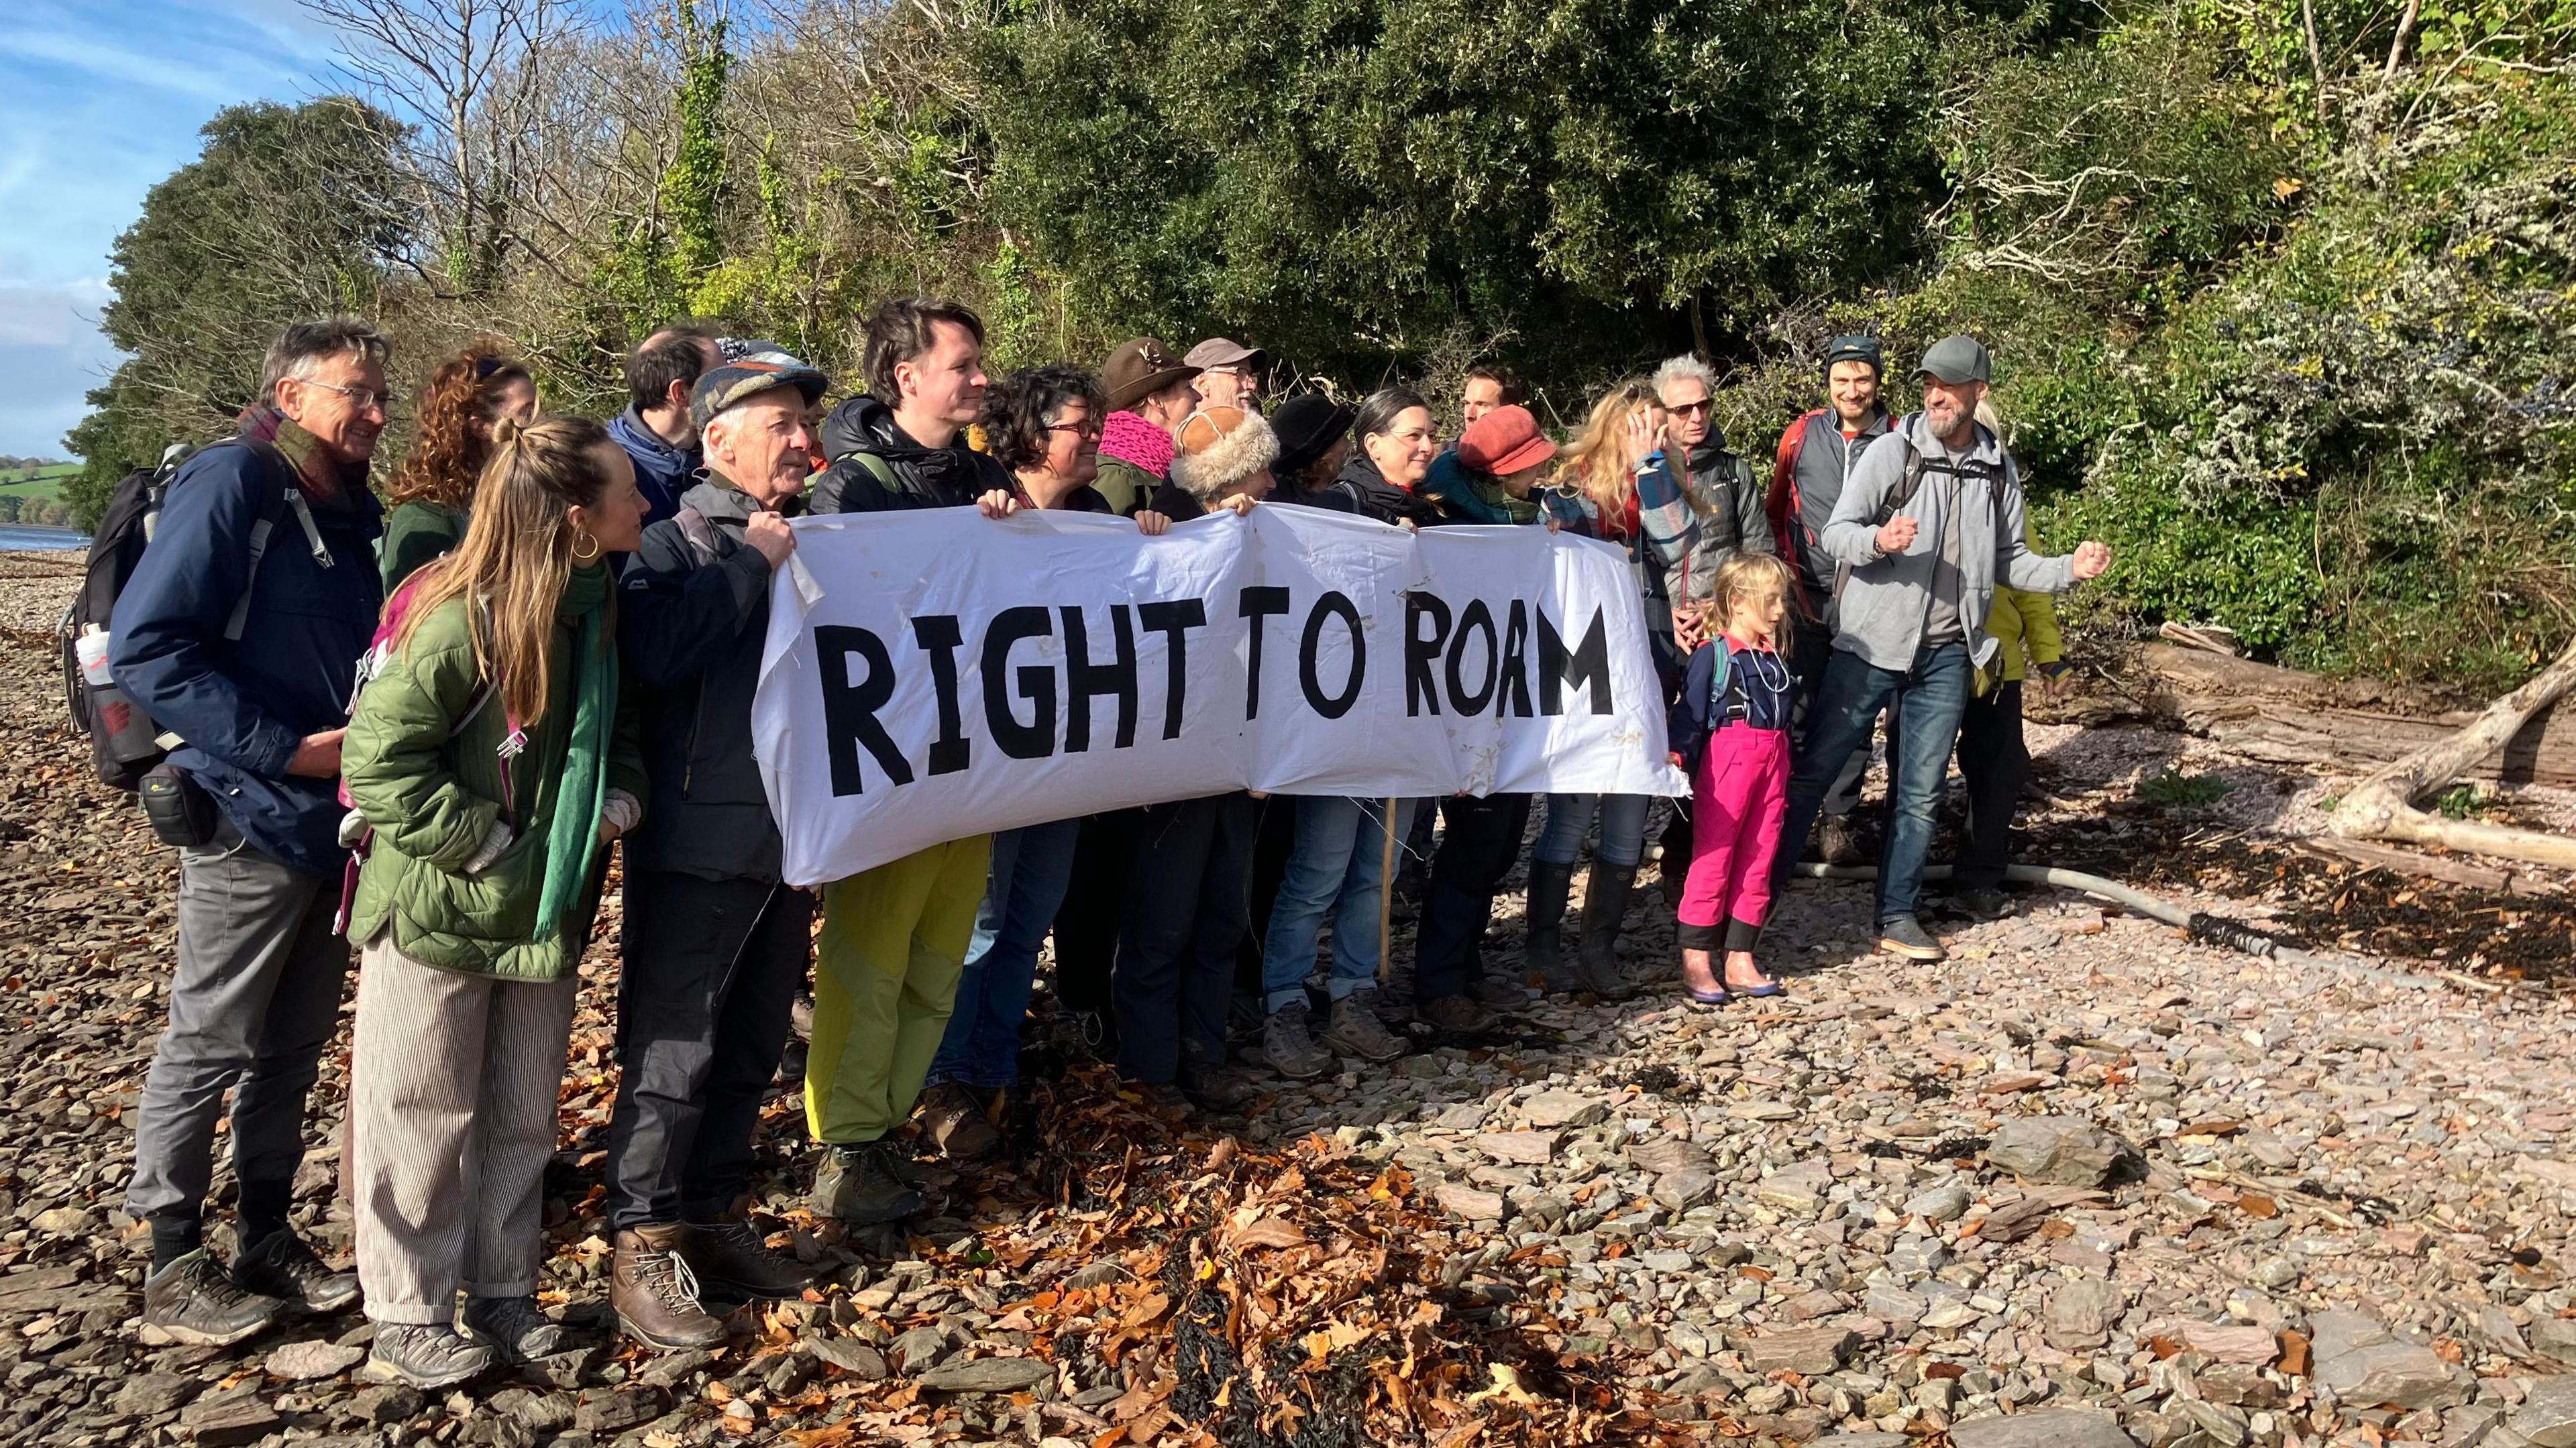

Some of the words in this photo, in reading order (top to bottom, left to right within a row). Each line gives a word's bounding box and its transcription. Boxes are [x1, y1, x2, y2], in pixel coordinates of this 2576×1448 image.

[814, 598, 1206, 797] RIGHT
[1238, 586, 1366, 721] TO
[1404, 590, 1613, 718] ROAM
